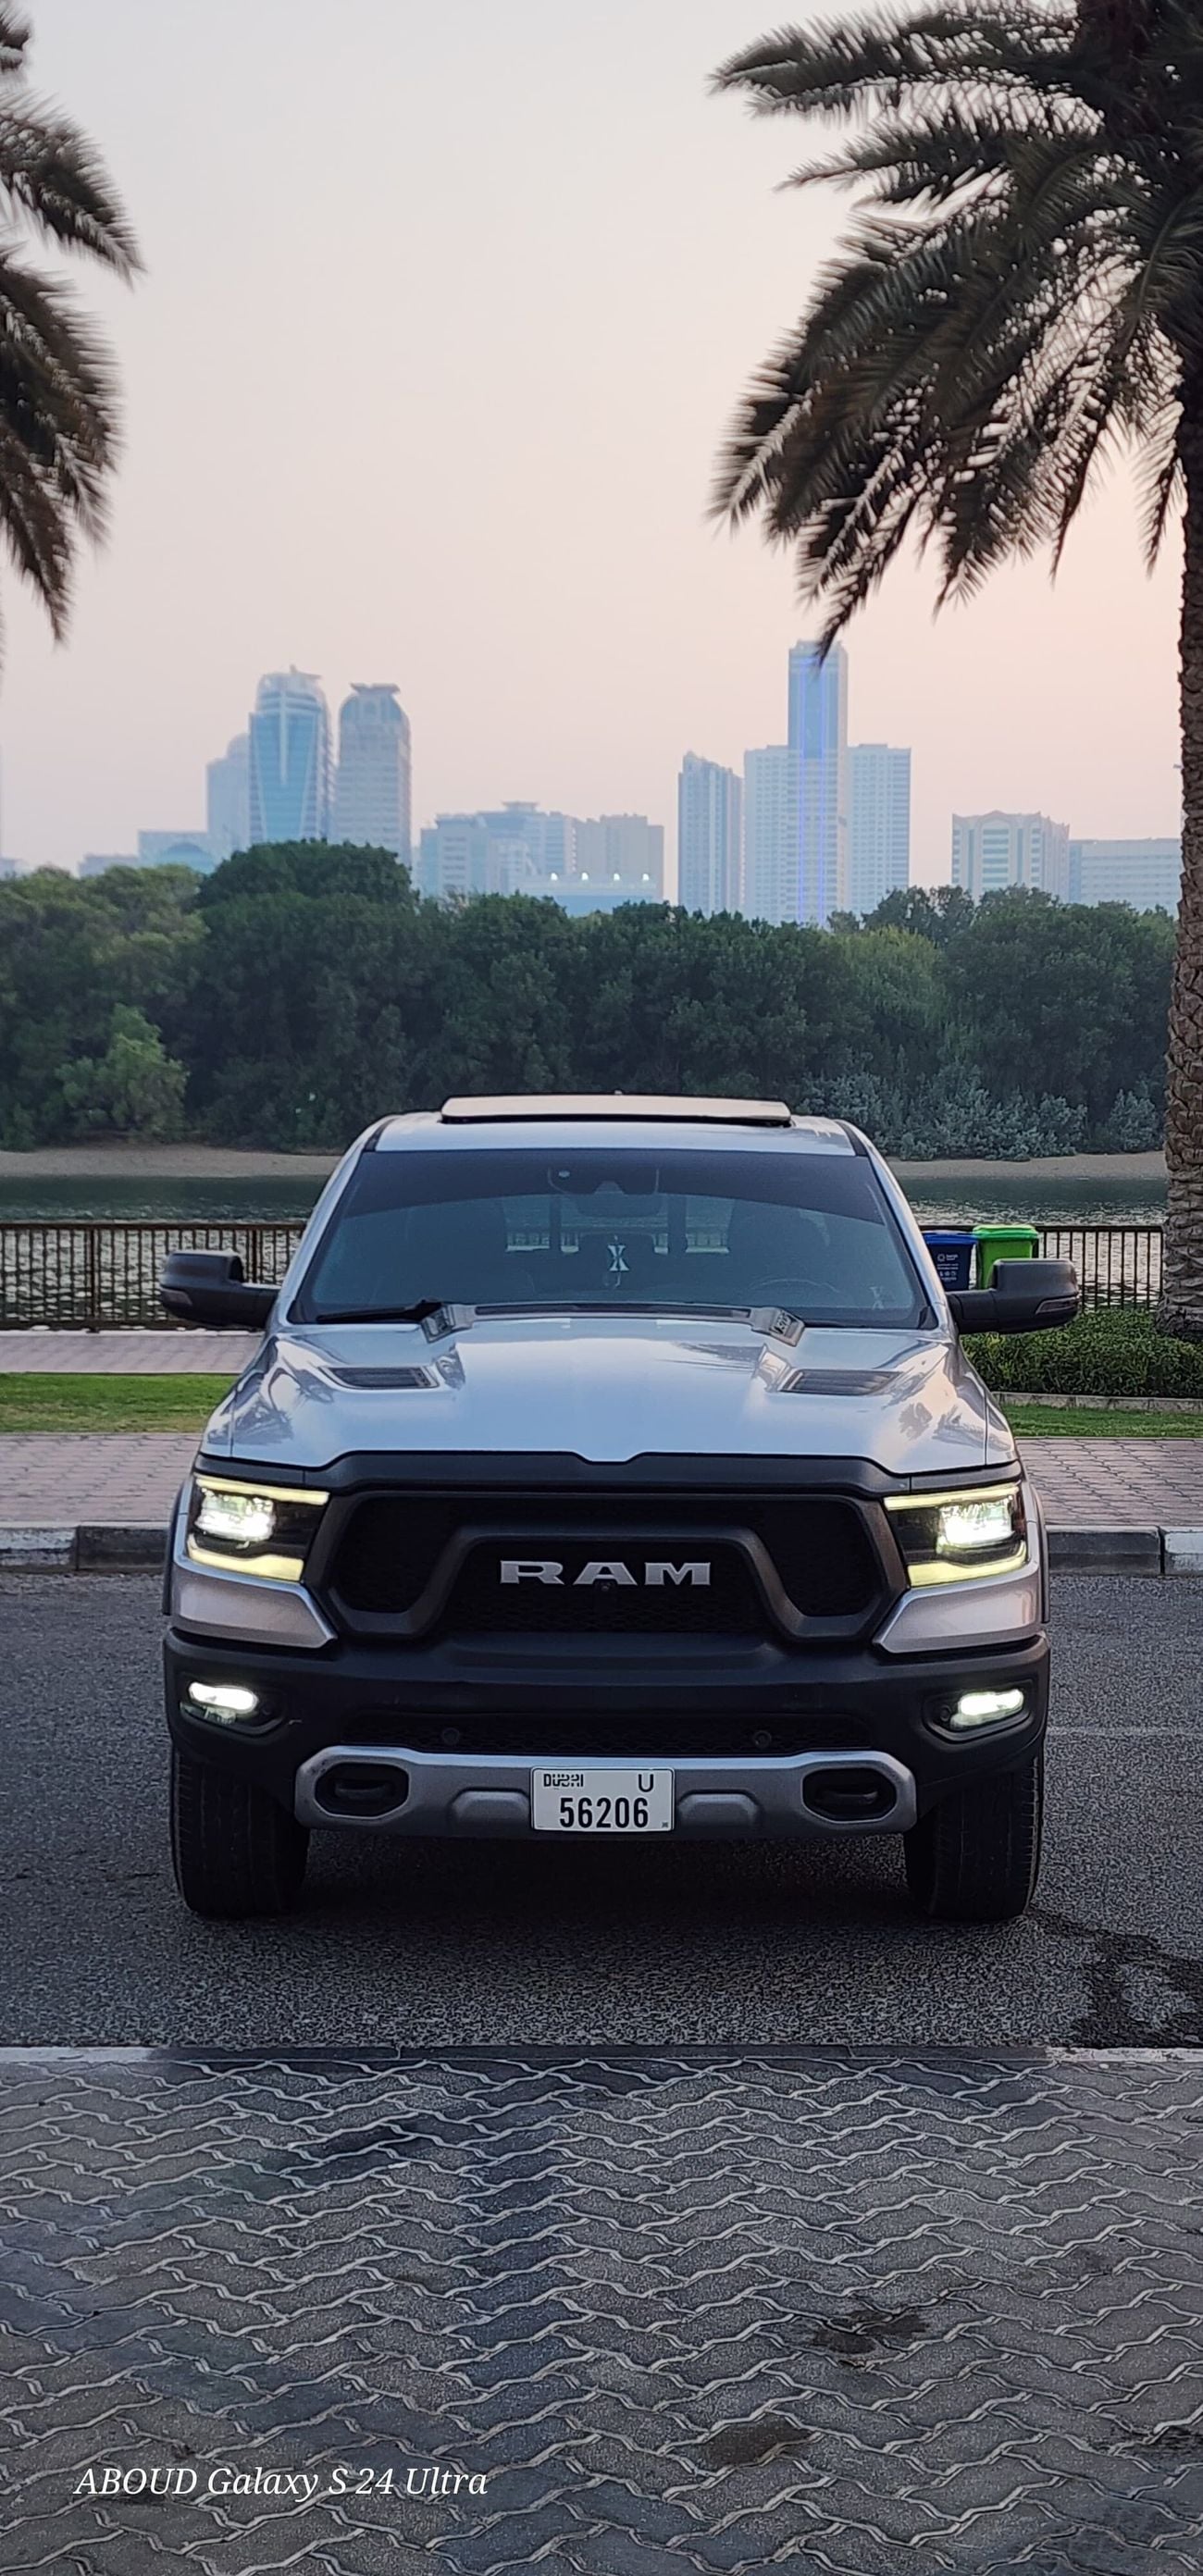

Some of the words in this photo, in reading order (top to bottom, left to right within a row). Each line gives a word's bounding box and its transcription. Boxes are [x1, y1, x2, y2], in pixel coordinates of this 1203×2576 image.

[500, 1560, 711, 1585] RAM
[543, 1773, 584, 1788] DUBAI
[638, 1773, 654, 1793] U
[559, 1797, 649, 1828] 56206
